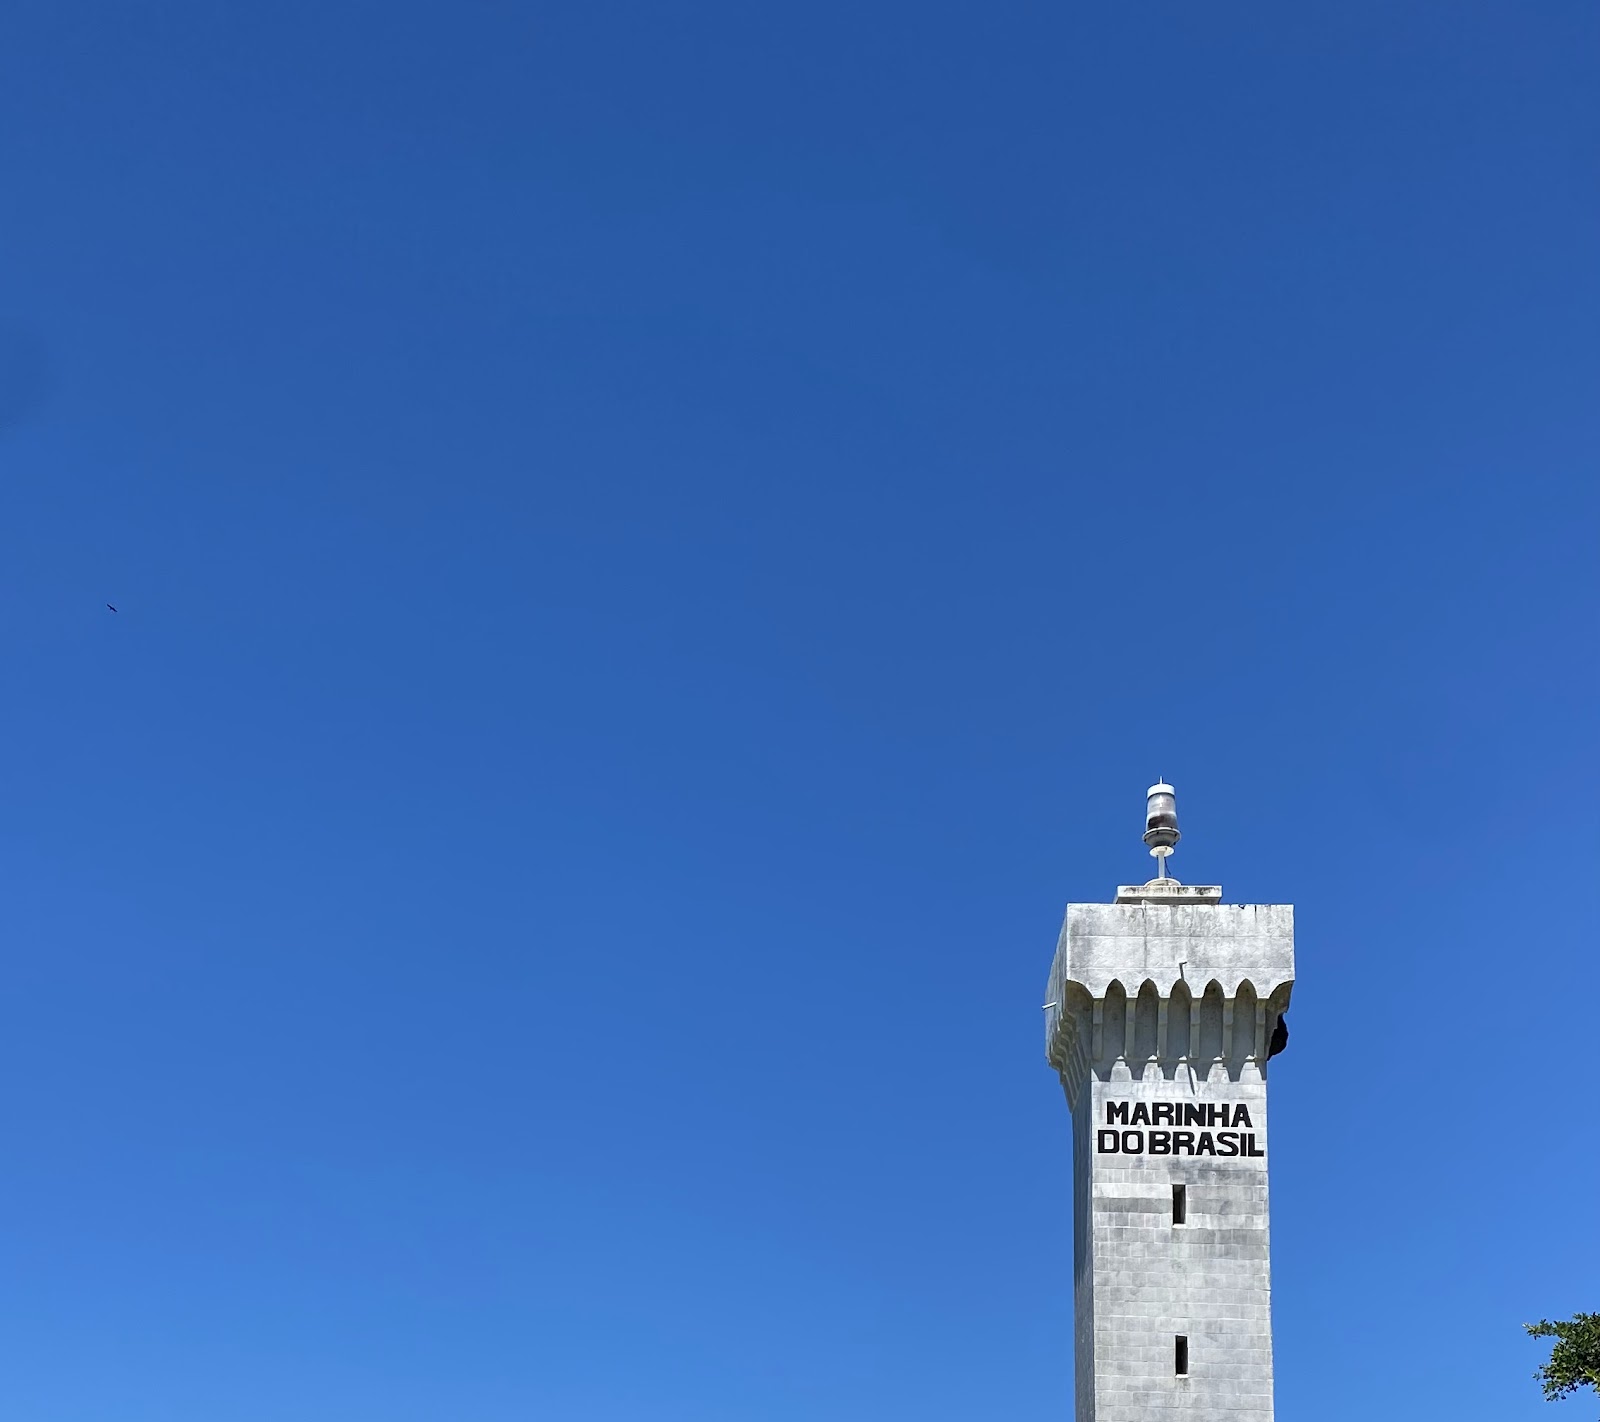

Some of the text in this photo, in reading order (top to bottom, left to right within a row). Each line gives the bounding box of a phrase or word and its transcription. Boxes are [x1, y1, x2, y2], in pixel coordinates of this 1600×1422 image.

[1106, 1101, 1253, 1128] MARINHA
[1097, 1129, 1265, 1157] DO BRASIL
